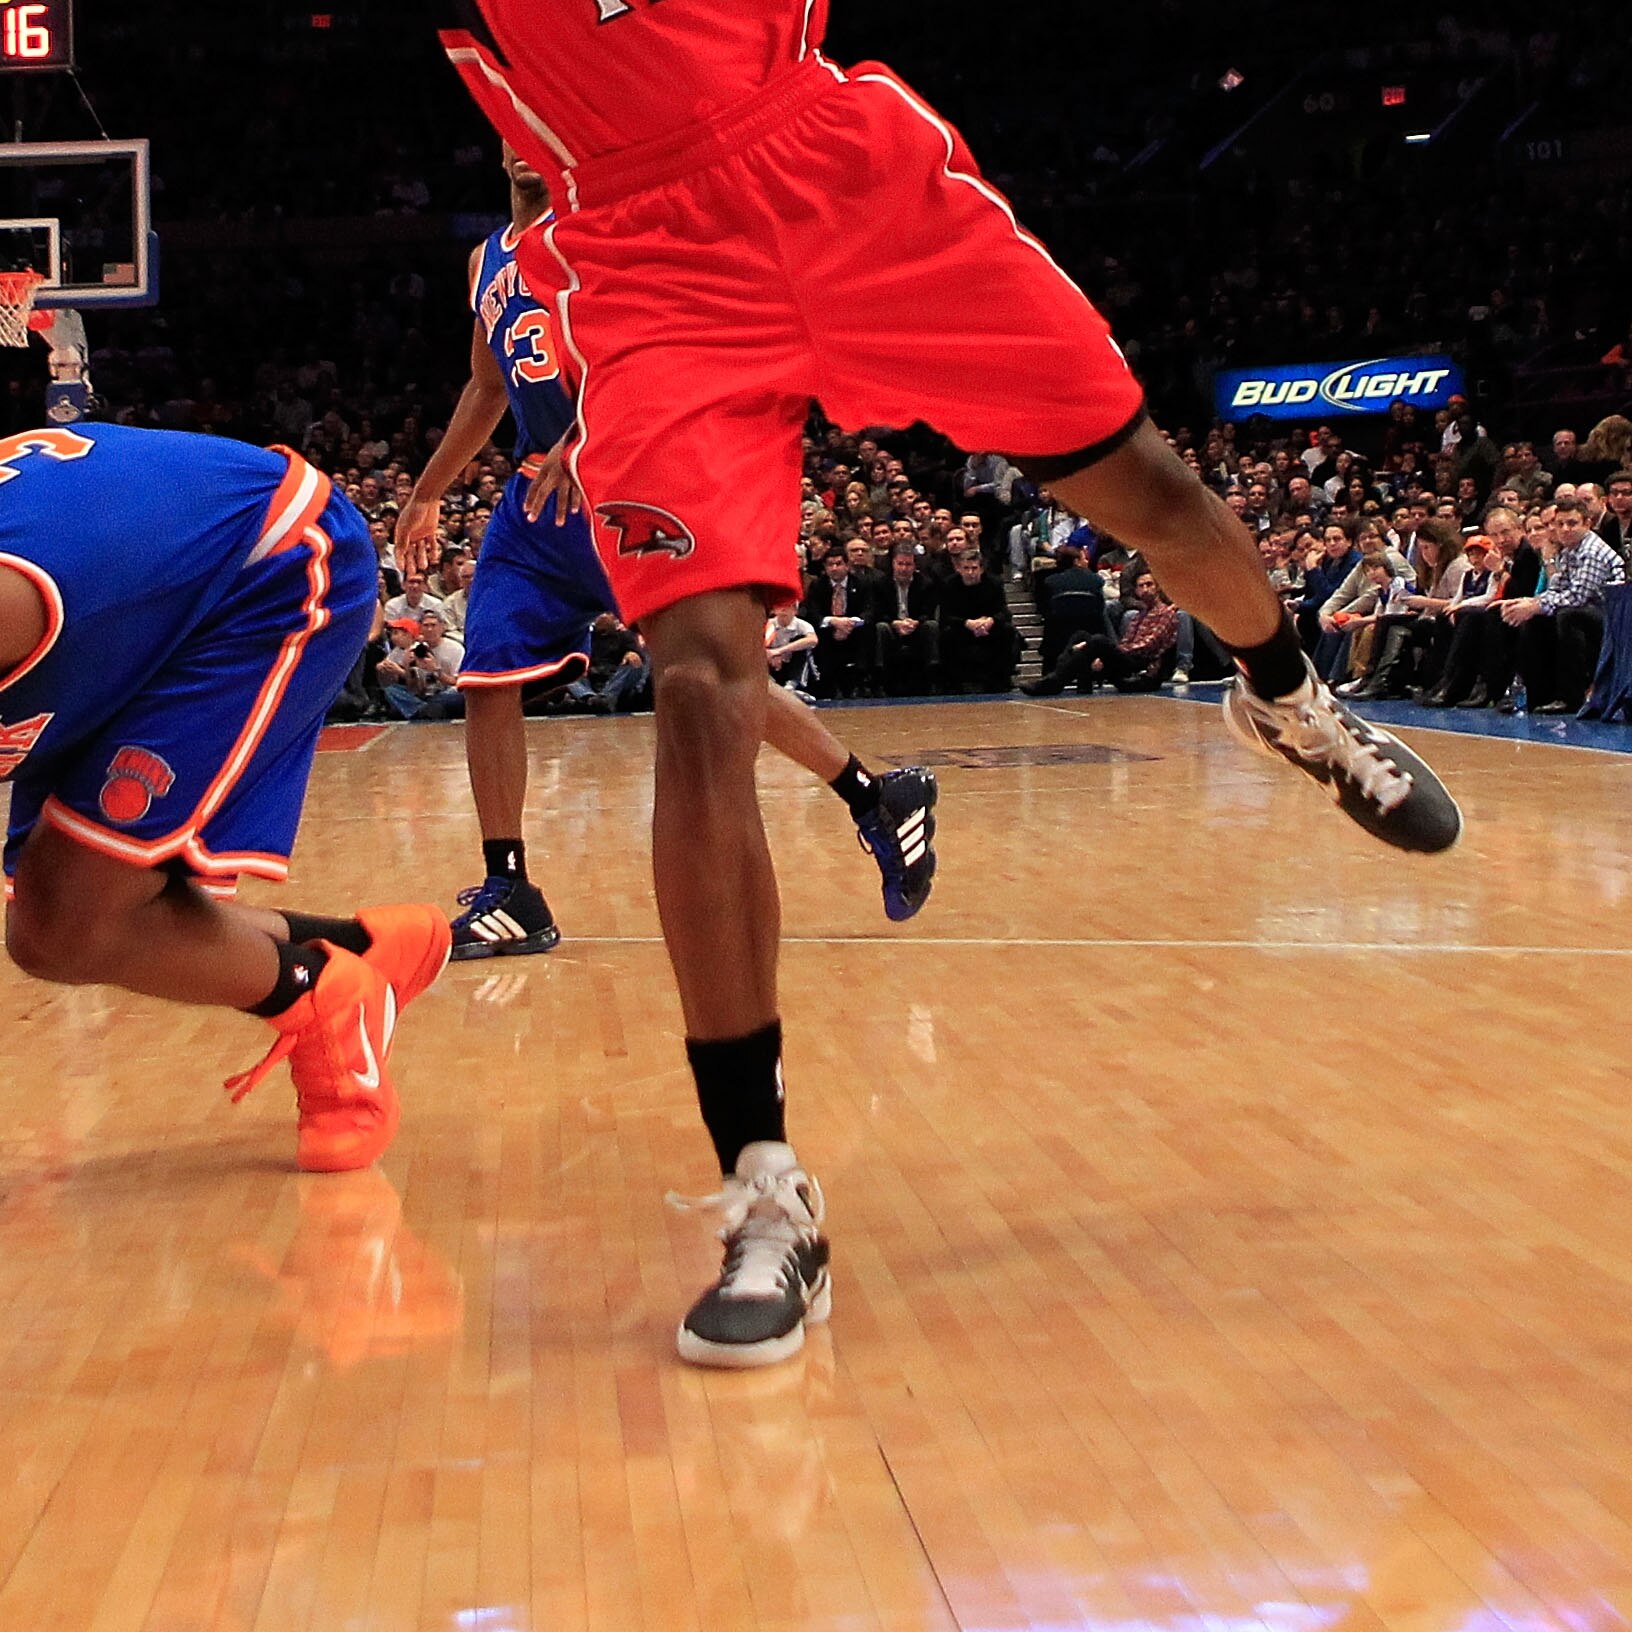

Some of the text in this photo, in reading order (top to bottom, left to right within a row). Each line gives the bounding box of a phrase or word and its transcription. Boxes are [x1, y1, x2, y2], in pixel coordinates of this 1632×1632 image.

[4, 5, 53, 59] 16
[1231, 369, 1450, 407] BUD LIGHT
